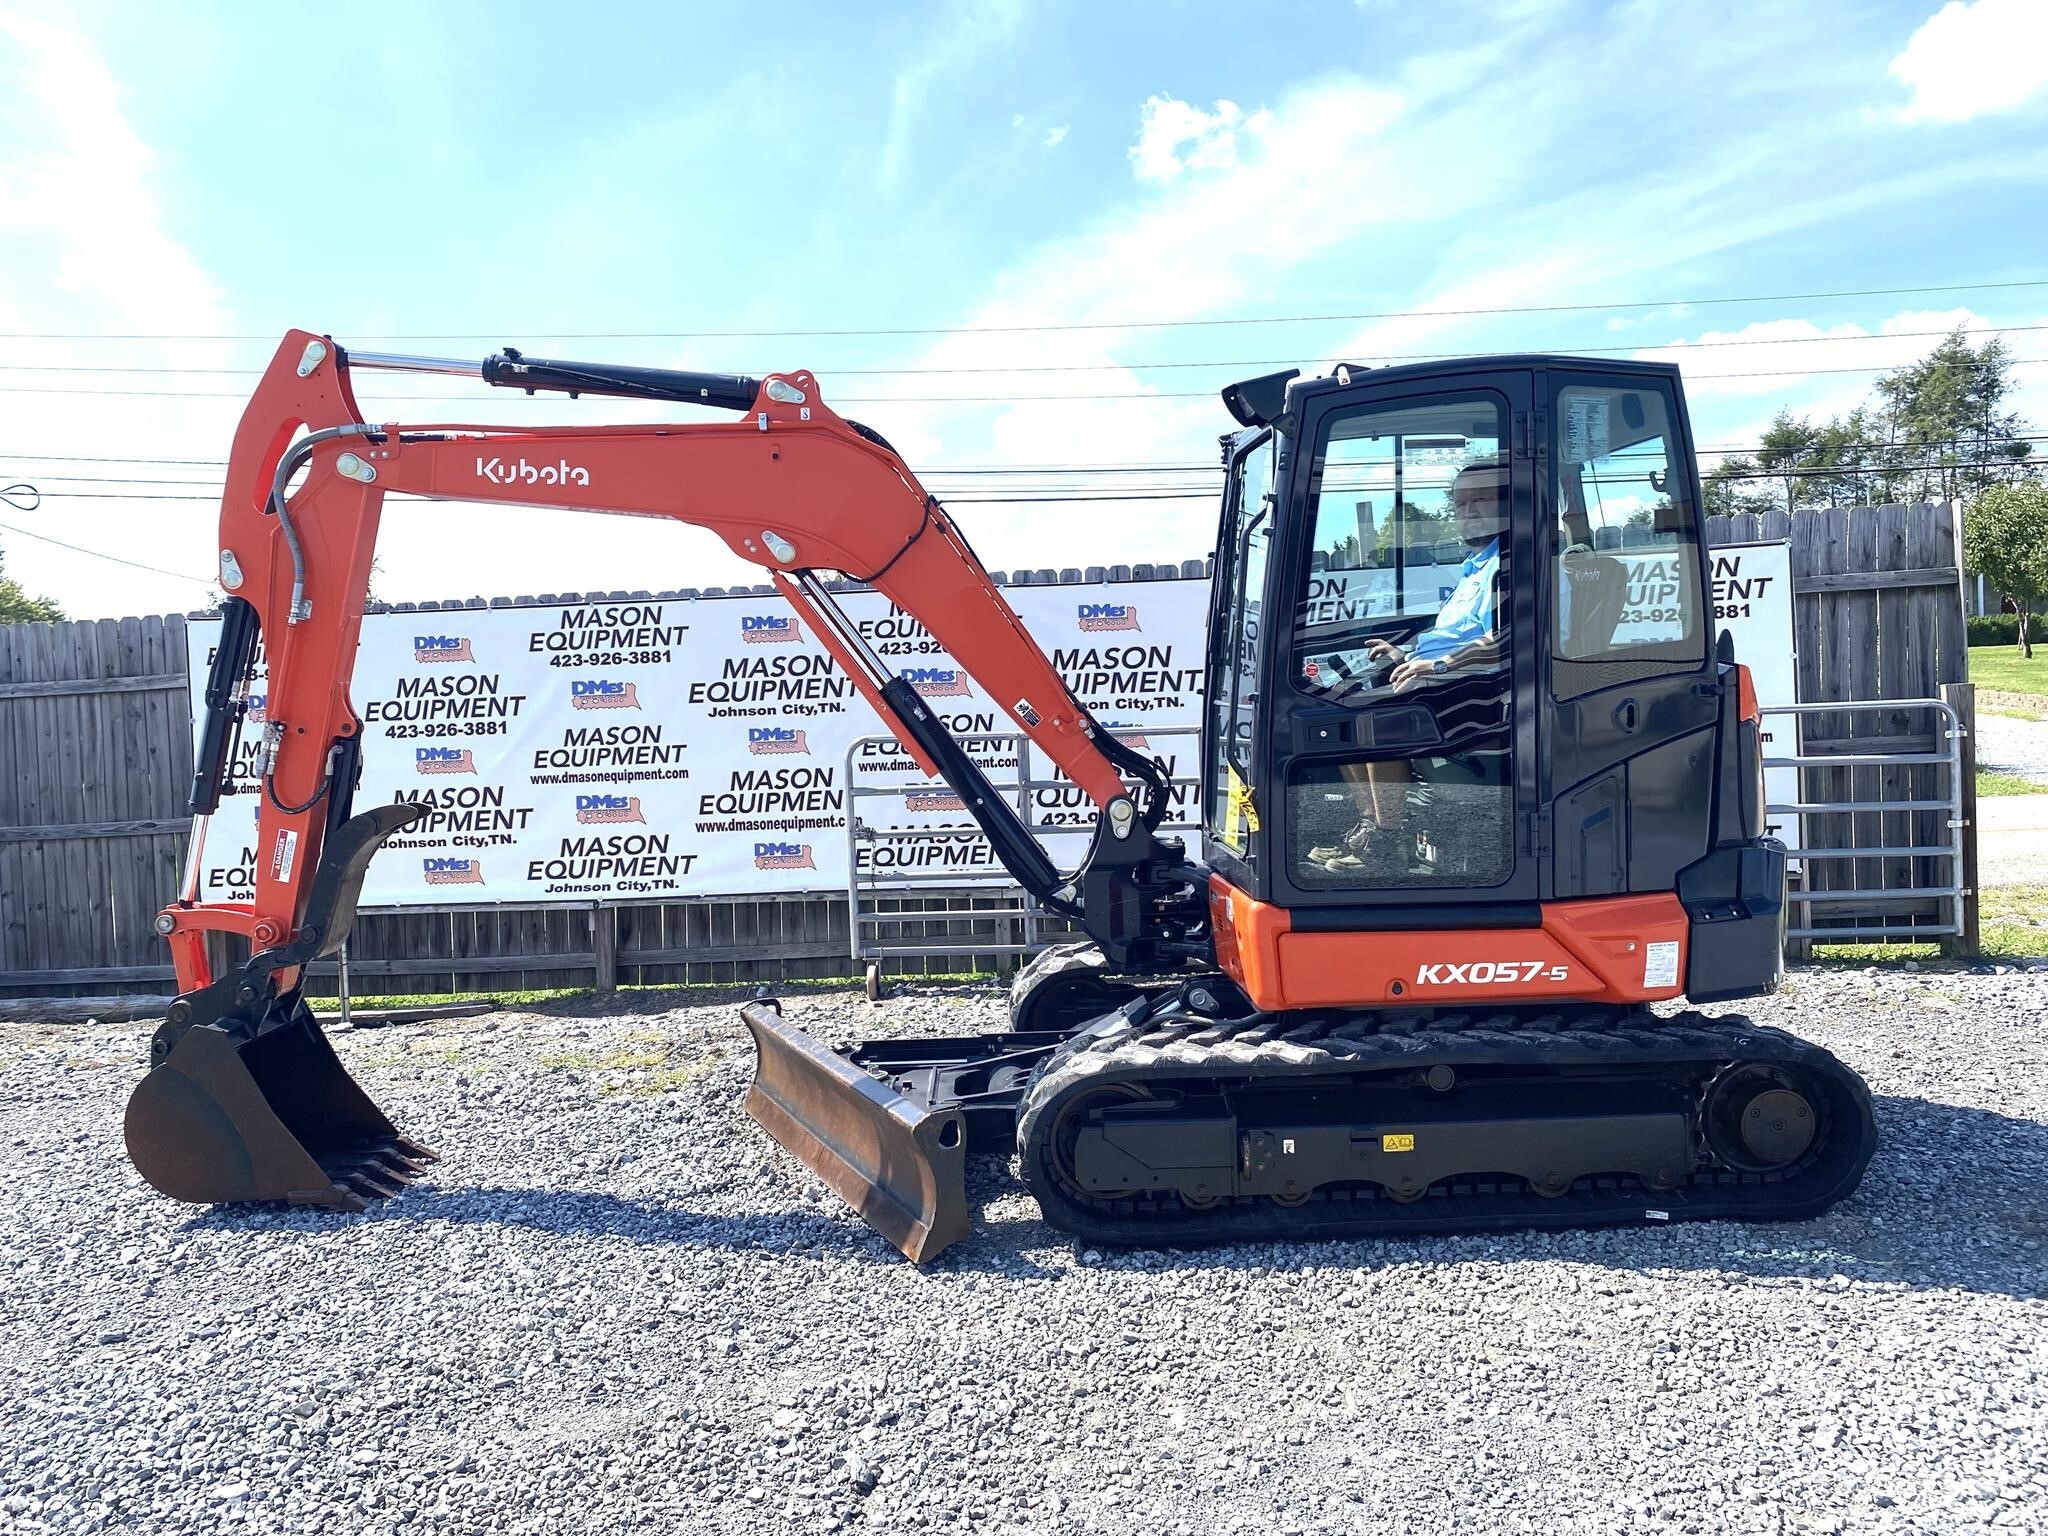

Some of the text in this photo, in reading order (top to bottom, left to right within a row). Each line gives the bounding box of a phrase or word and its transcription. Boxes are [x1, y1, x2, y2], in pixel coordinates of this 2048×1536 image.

[476, 457, 590, 486] Kubota
[561, 606, 663, 629] MASON
[529, 626, 689, 652] EQUIPMENT
[550, 650, 671, 668] 423-926-3881
[722, 655, 834, 679] MASON
[1053, 645, 1172, 671] MASON
[396, 674, 499, 698] MASON
[365, 696, 526, 722] EQUIPMENT
[708, 702, 846, 718] Johnson City,TN.
[1115, 696, 1185, 711] City,TN.
[385, 721, 507, 739] 423-926-3881
[939, 713, 994, 732] SON
[564, 725, 662, 747] MASON
[534, 744, 687, 769] EQUIPMENT
[530, 768, 689, 785] www.dmasonequipment.com
[730, 767, 834, 792] MASON
[699, 790, 844, 815] EQUIPMEN
[275, 838, 286, 865] DANGER
[452, 834, 517, 847] City,TN.
[560, 834, 670, 858] MASON
[527, 855, 697, 881] EQUIPMENT
[544, 879, 680, 893] Johnson City,TN.
[1415, 961, 1569, 985] KX057-5
